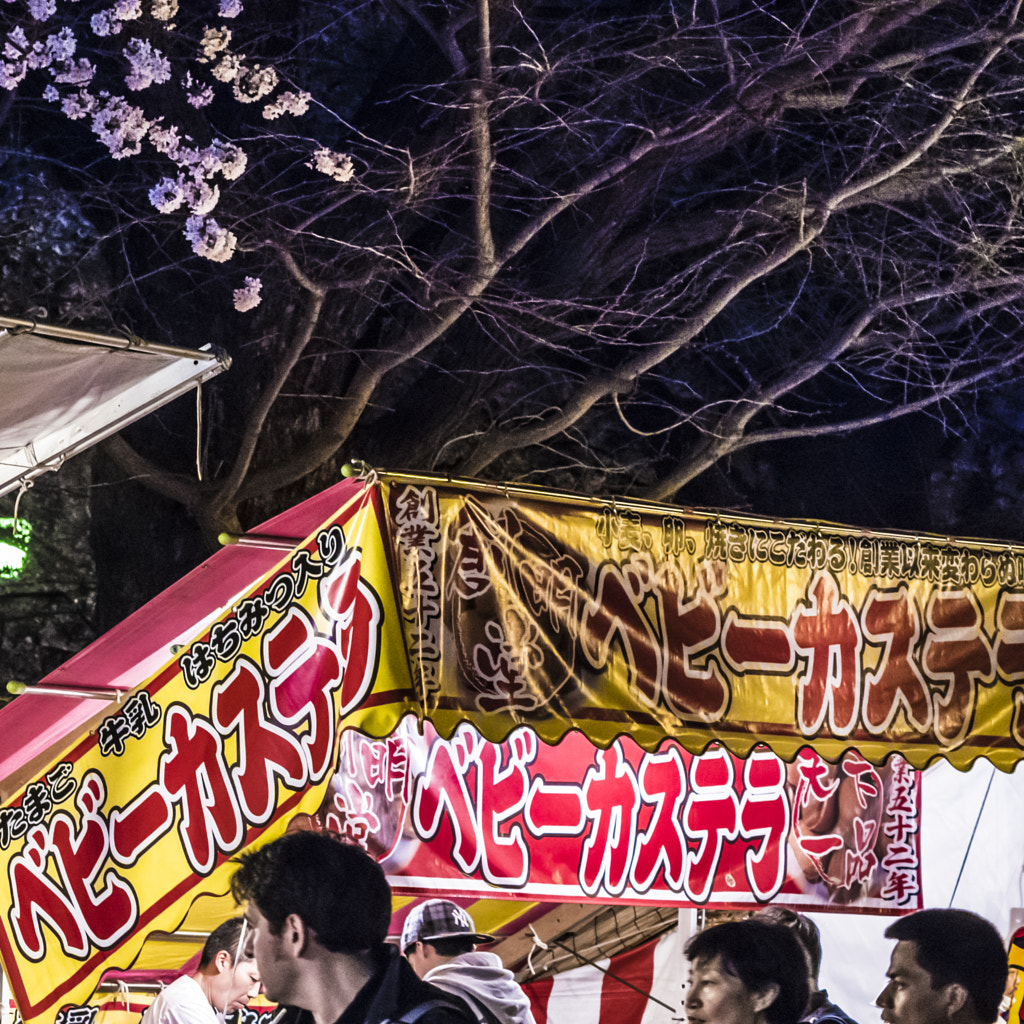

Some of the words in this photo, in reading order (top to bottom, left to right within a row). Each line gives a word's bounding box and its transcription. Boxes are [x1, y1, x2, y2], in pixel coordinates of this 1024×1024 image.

[180, 524, 346, 689] はちみつ入り
[8, 547, 384, 963] ベビーカステラ
[98, 690, 161, 757] 牛乳
[411, 720, 791, 905] ベビーカステラ
